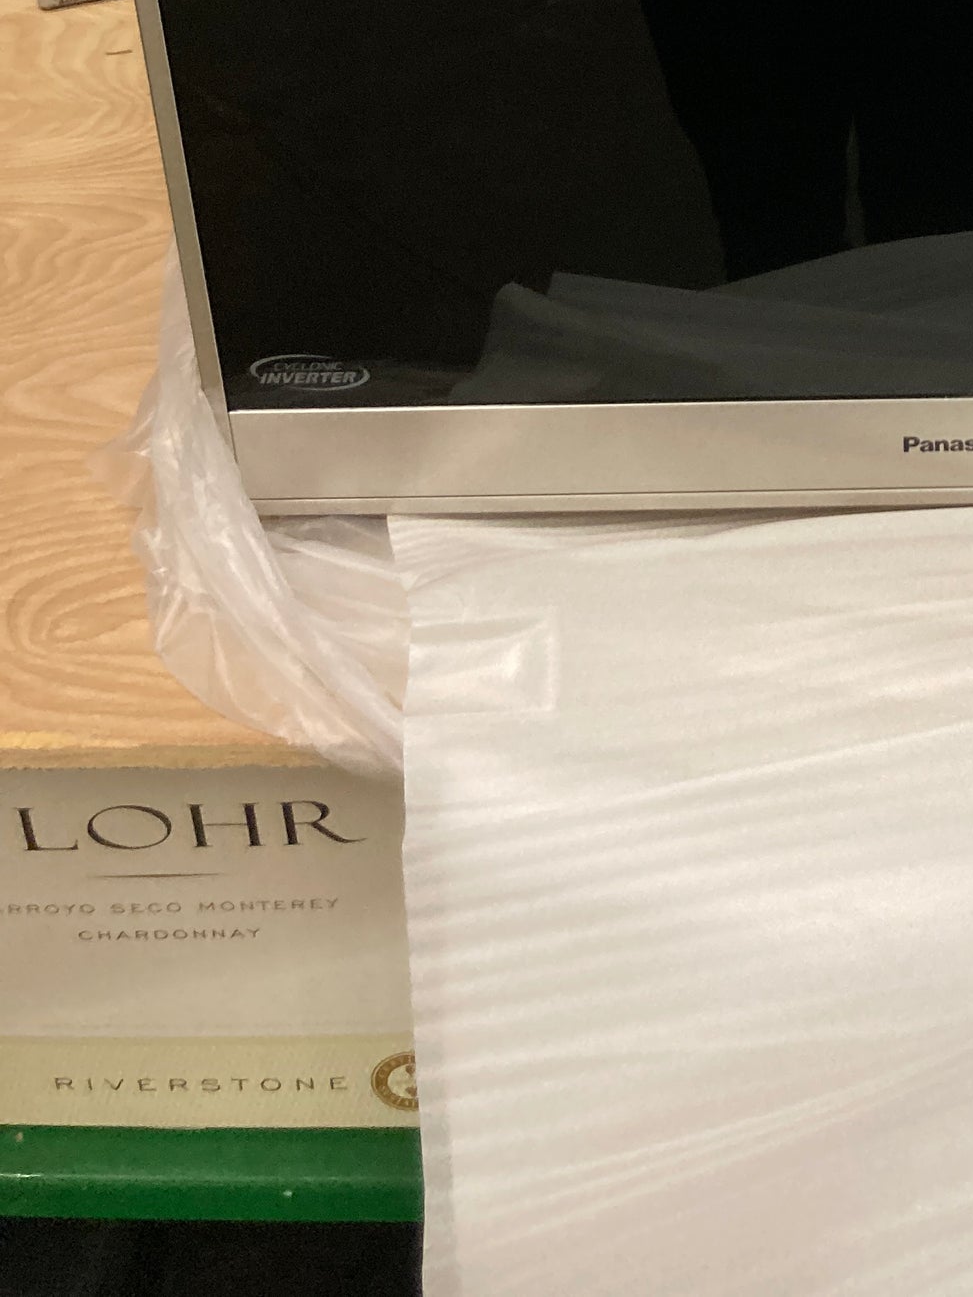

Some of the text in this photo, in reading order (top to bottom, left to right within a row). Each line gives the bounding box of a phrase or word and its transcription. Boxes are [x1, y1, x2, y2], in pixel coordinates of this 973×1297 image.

[273, 361, 346, 372] CYCLONIC
[259, 371, 357, 384] INVERTER
[14, 800, 368, 851] LOHR
[198, 897, 339, 912] MONTEREY
[77, 927, 261, 941] CHARDONNAY
[53, 1075, 350, 1093] RIVERSTONE
